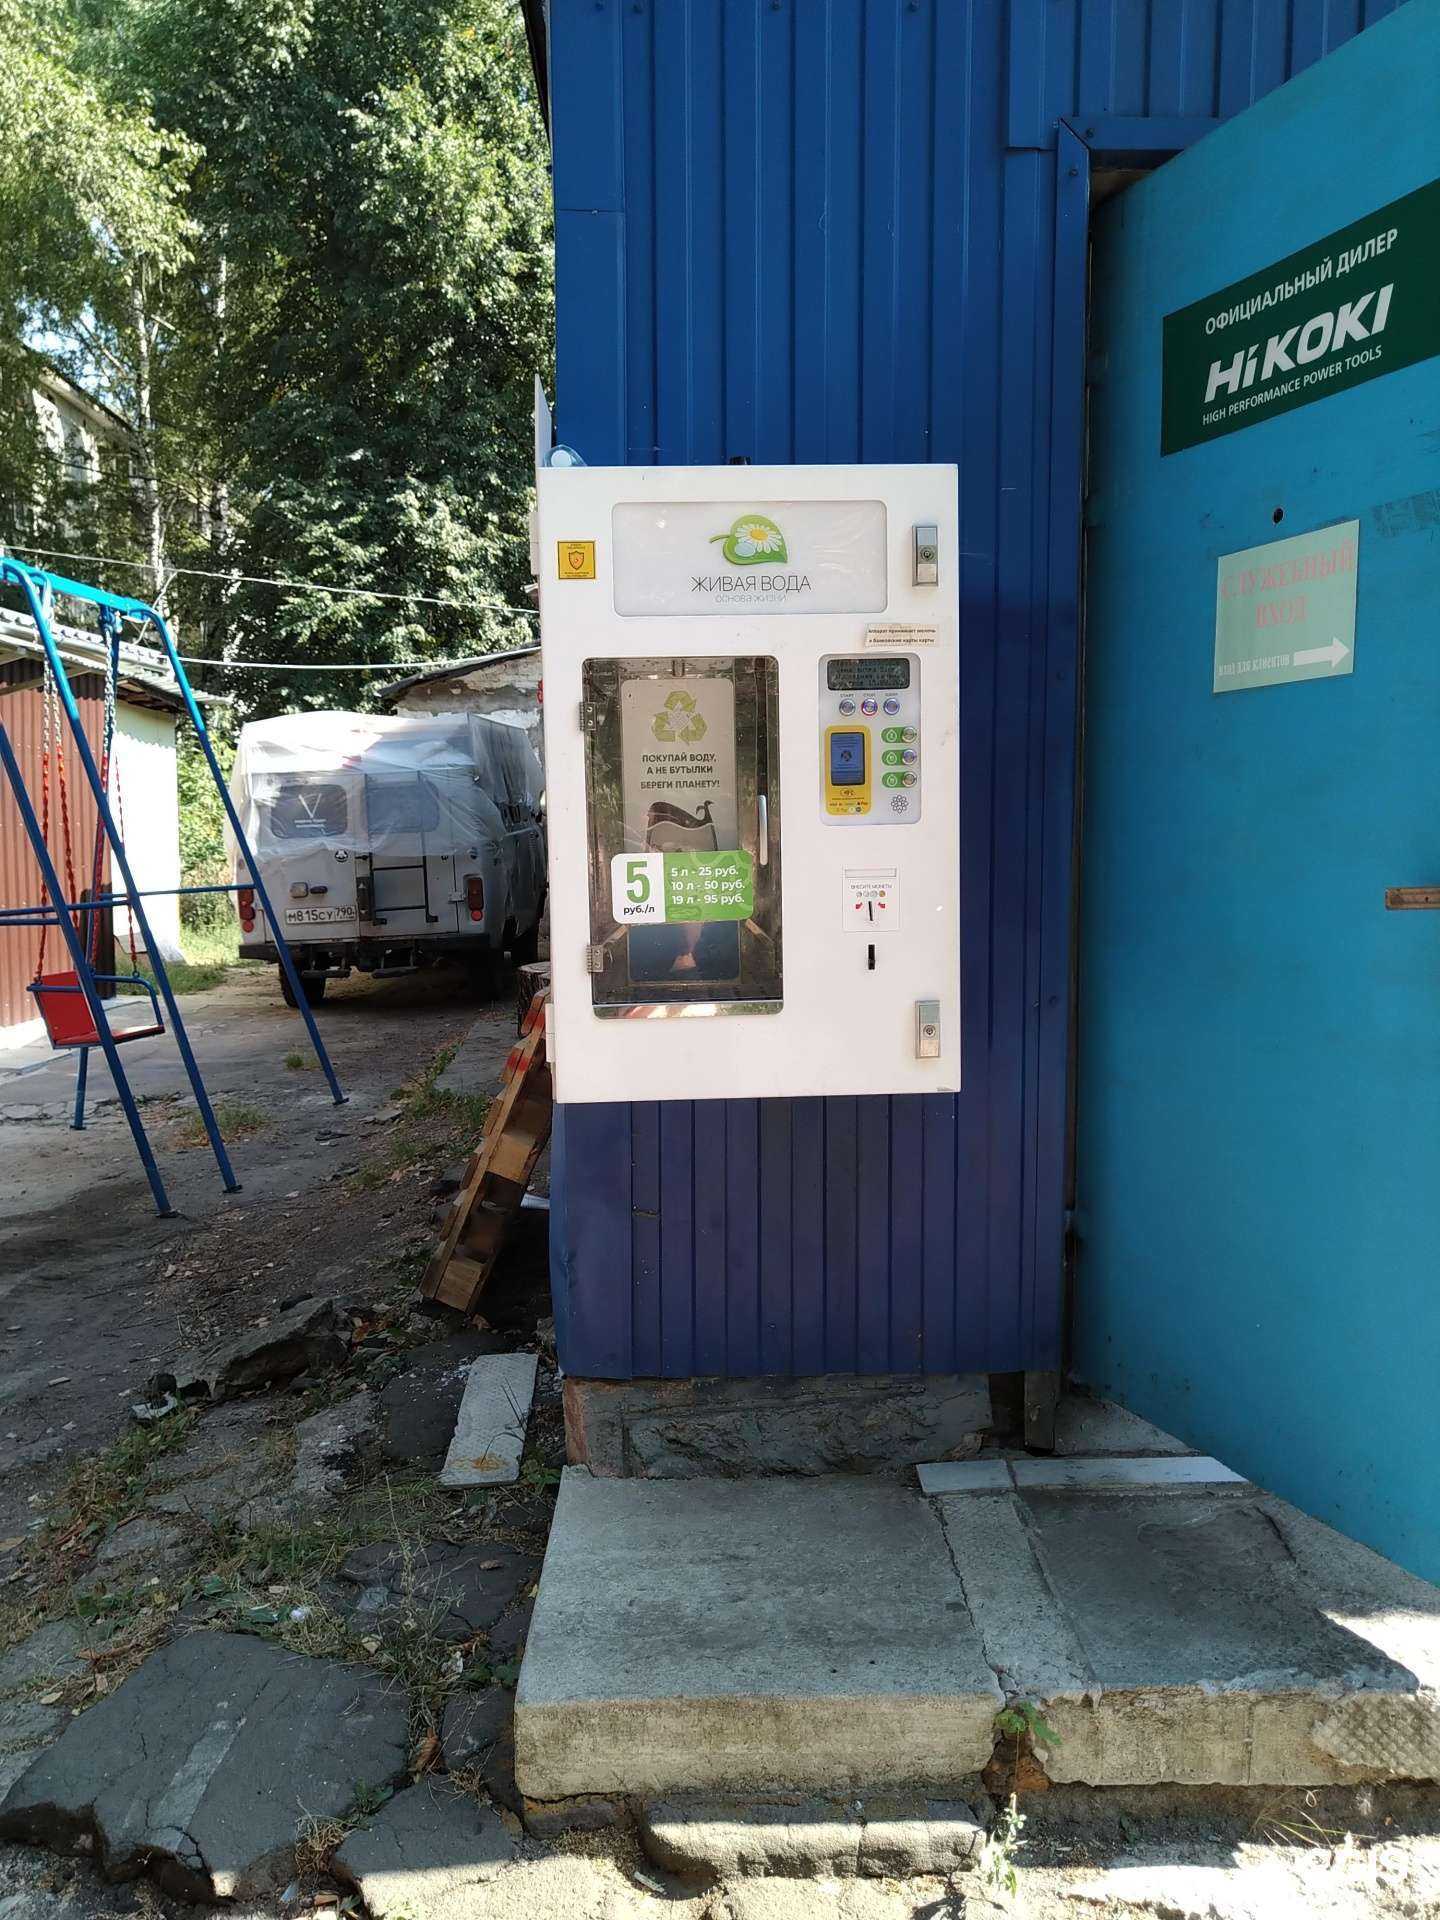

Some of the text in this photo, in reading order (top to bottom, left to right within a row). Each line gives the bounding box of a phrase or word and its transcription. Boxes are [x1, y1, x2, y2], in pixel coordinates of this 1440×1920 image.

[1205, 228, 1399, 335] ОФИЦИАЛЬНЫЙ ДИЛЕР
[1202, 345, 1382, 426] HIGH PERFORMANCE POWER TOOLS
[691, 575, 812, 594] ЖИВАЯ ВОДА
[642, 751, 717, 765] ПОКУПАЙ ВОДУ,
[647, 765, 713, 775] А НЕ БУТЫЛКИ
[641, 779, 721, 790] БЕРЕГИ ПЛАНЕТУ!
[671, 868, 678, 877] 5
[680, 868, 688, 876] л
[698, 867, 712, 876] 25
[714, 865, 739, 878] руб.
[626, 860, 651, 903] 5
[671, 882, 684, 891] 10
[686, 882, 694, 890] л
[704, 881, 718, 890] 50
[721, 879, 745, 892] руб.
[672, 896, 684, 905] 19
[686, 896, 694, 904] л
[704, 895, 718, 904] 95
[720, 893, 745, 906] руб.
[623, 904, 655, 915] руб./л
